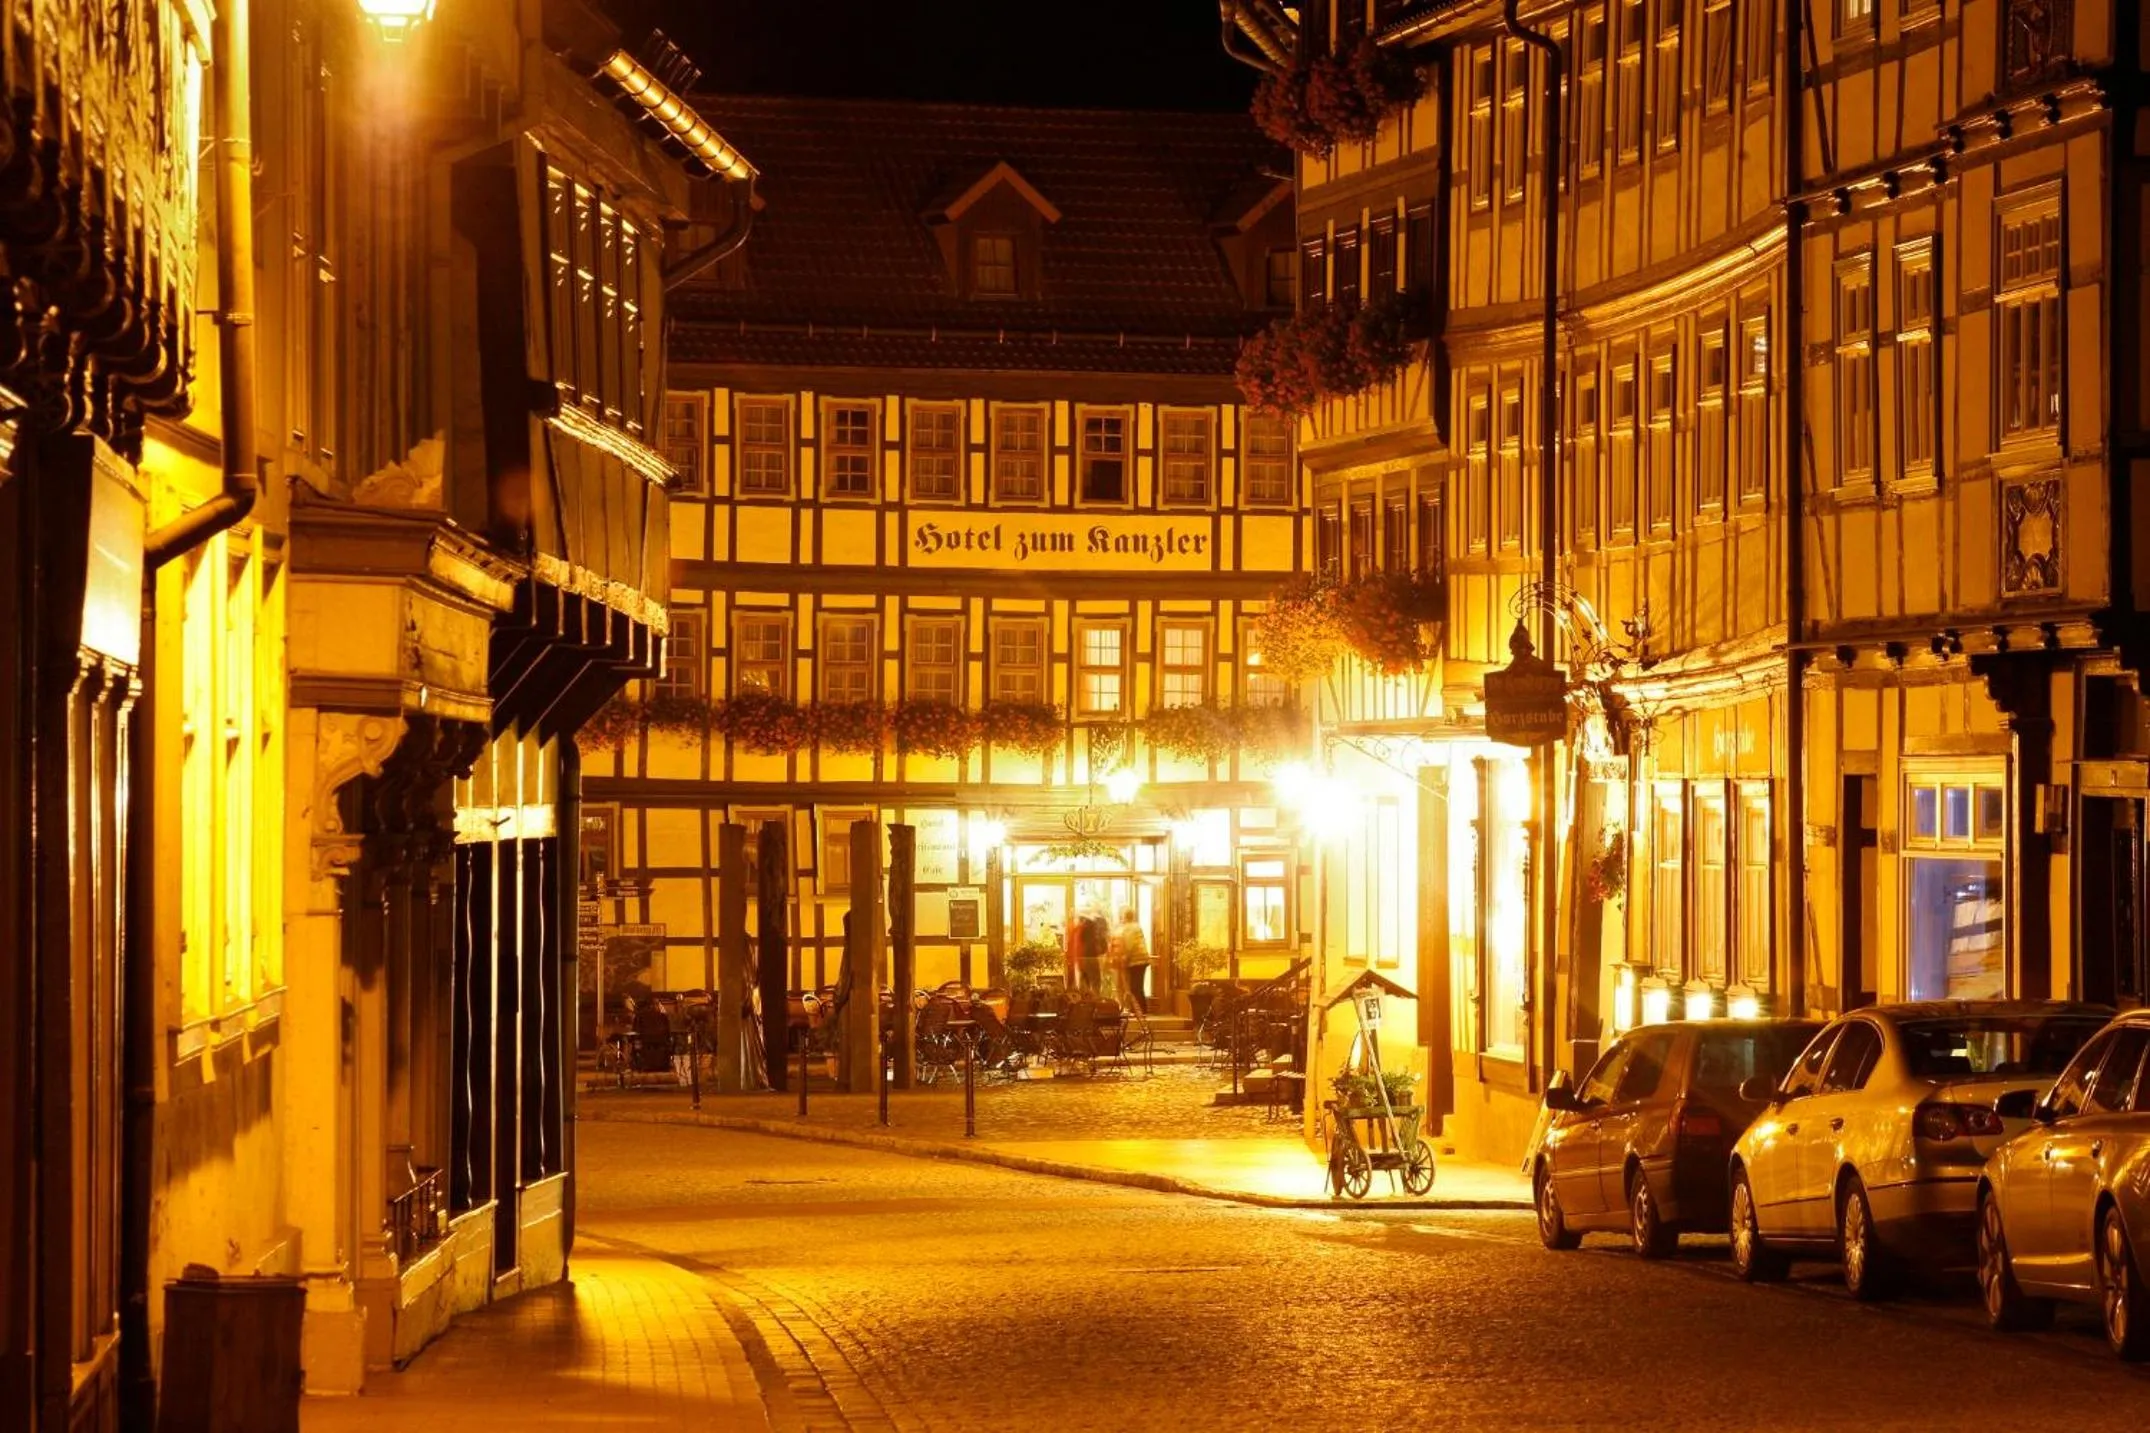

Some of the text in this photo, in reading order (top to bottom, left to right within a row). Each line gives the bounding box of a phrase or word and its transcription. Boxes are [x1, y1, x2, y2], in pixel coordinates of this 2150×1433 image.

[914, 523, 1207, 564] Hotel zum Kanzler
